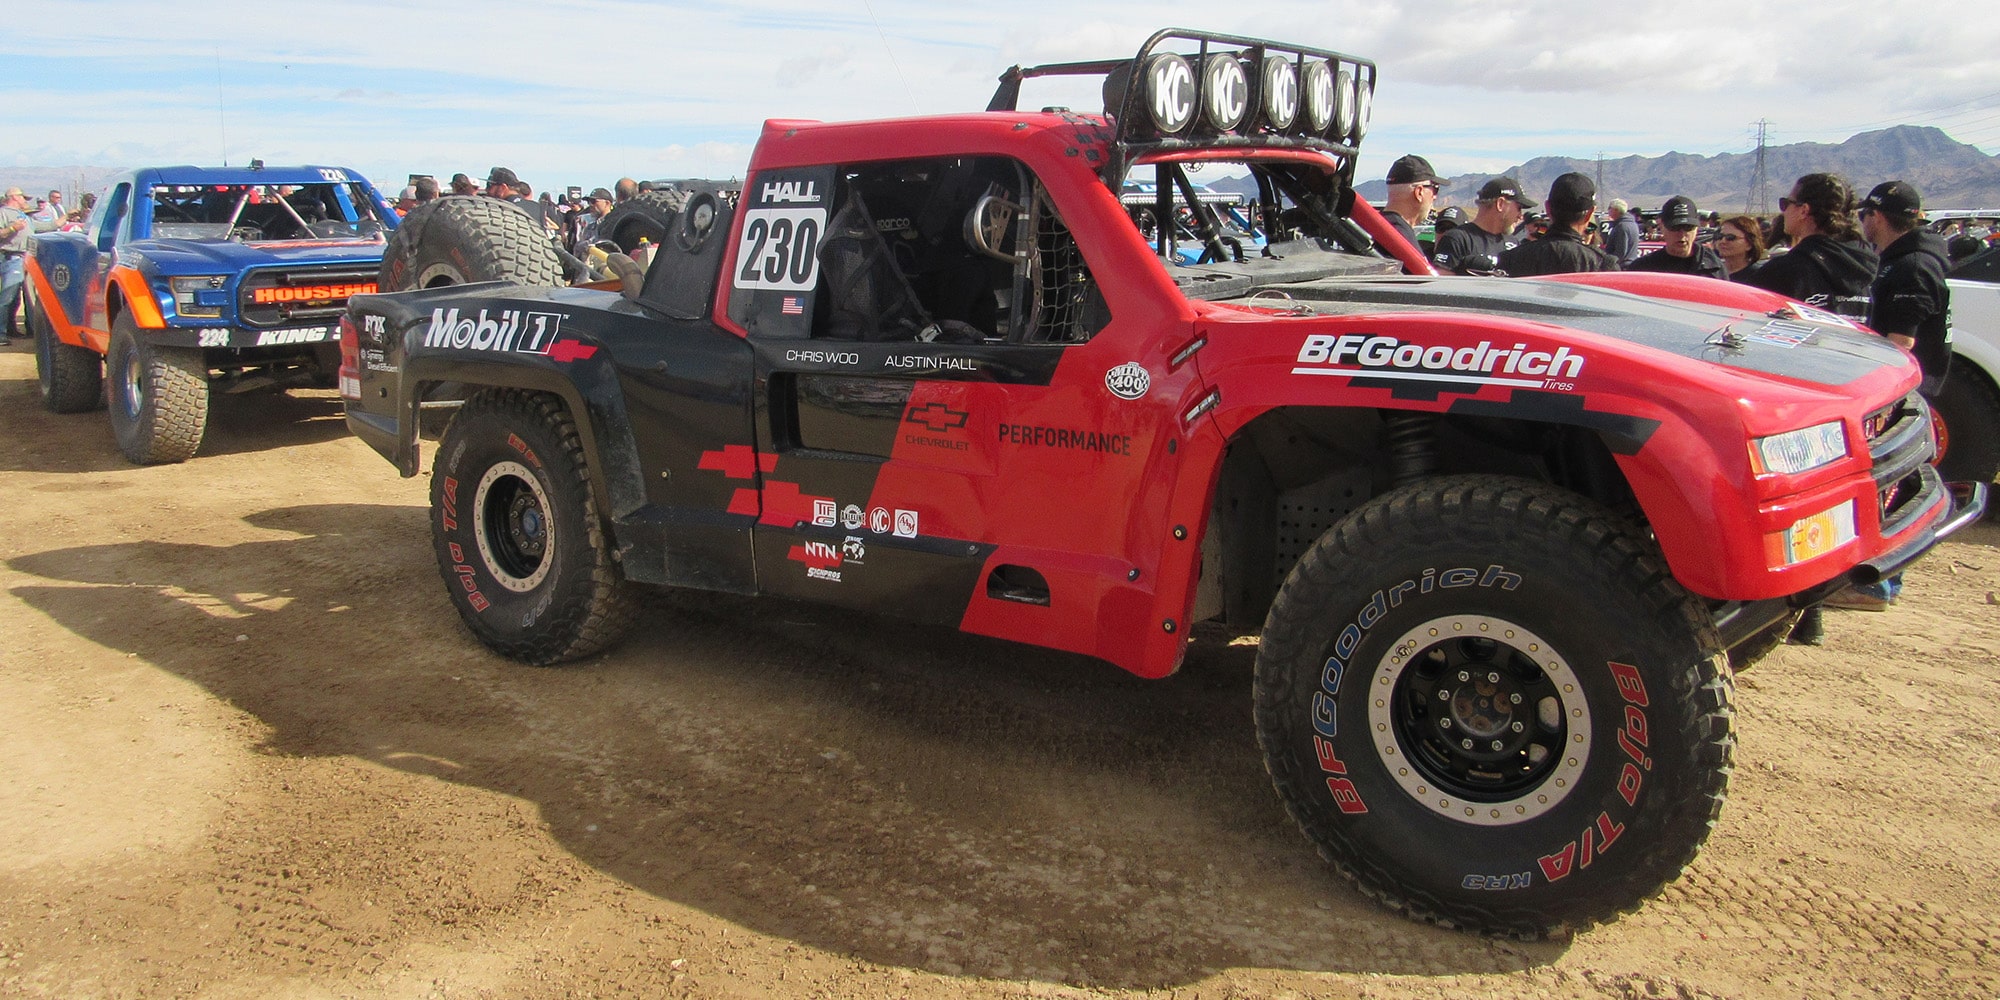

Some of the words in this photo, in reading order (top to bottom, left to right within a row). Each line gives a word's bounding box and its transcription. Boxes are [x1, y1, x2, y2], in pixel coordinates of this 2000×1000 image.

[1155, 61, 1189, 126] KC
[1213, 63, 1242, 124] KC
[1272, 64, 1294, 122] KC
[1314, 69, 1333, 124] KC
[1342, 78, 1355, 129] KC
[761, 181, 820, 203] HALL
[740, 218, 818, 284] 230
[198, 328, 231, 347] 224
[257, 327, 327, 346] KING
[424, 308, 520, 351] Mobil
[530, 316, 547, 350] 1
[786, 350, 824, 363] CHRIS
[826, 352, 859, 365] WOO
[884, 355, 938, 369] AUSTIN
[939, 358, 977, 370] HALL
[1110, 366, 1149, 380] MINT
[1297, 334, 1584, 378] BFGoodrich
[1114, 375, 1142, 391] 400
[1543, 379, 1574, 391] Tires
[905, 435, 970, 451] CHEVROLET
[999, 423, 1131, 456] PERFORMANCE
[873, 509, 887, 532] KC
[805, 540, 837, 560] NTN
[450, 542, 490, 612] Baja
[1312, 564, 1522, 814] BFGoodrich
[1607, 661, 1652, 806] Baja
[1537, 811, 1625, 882] T/A
[1462, 871, 1532, 890] KR3
